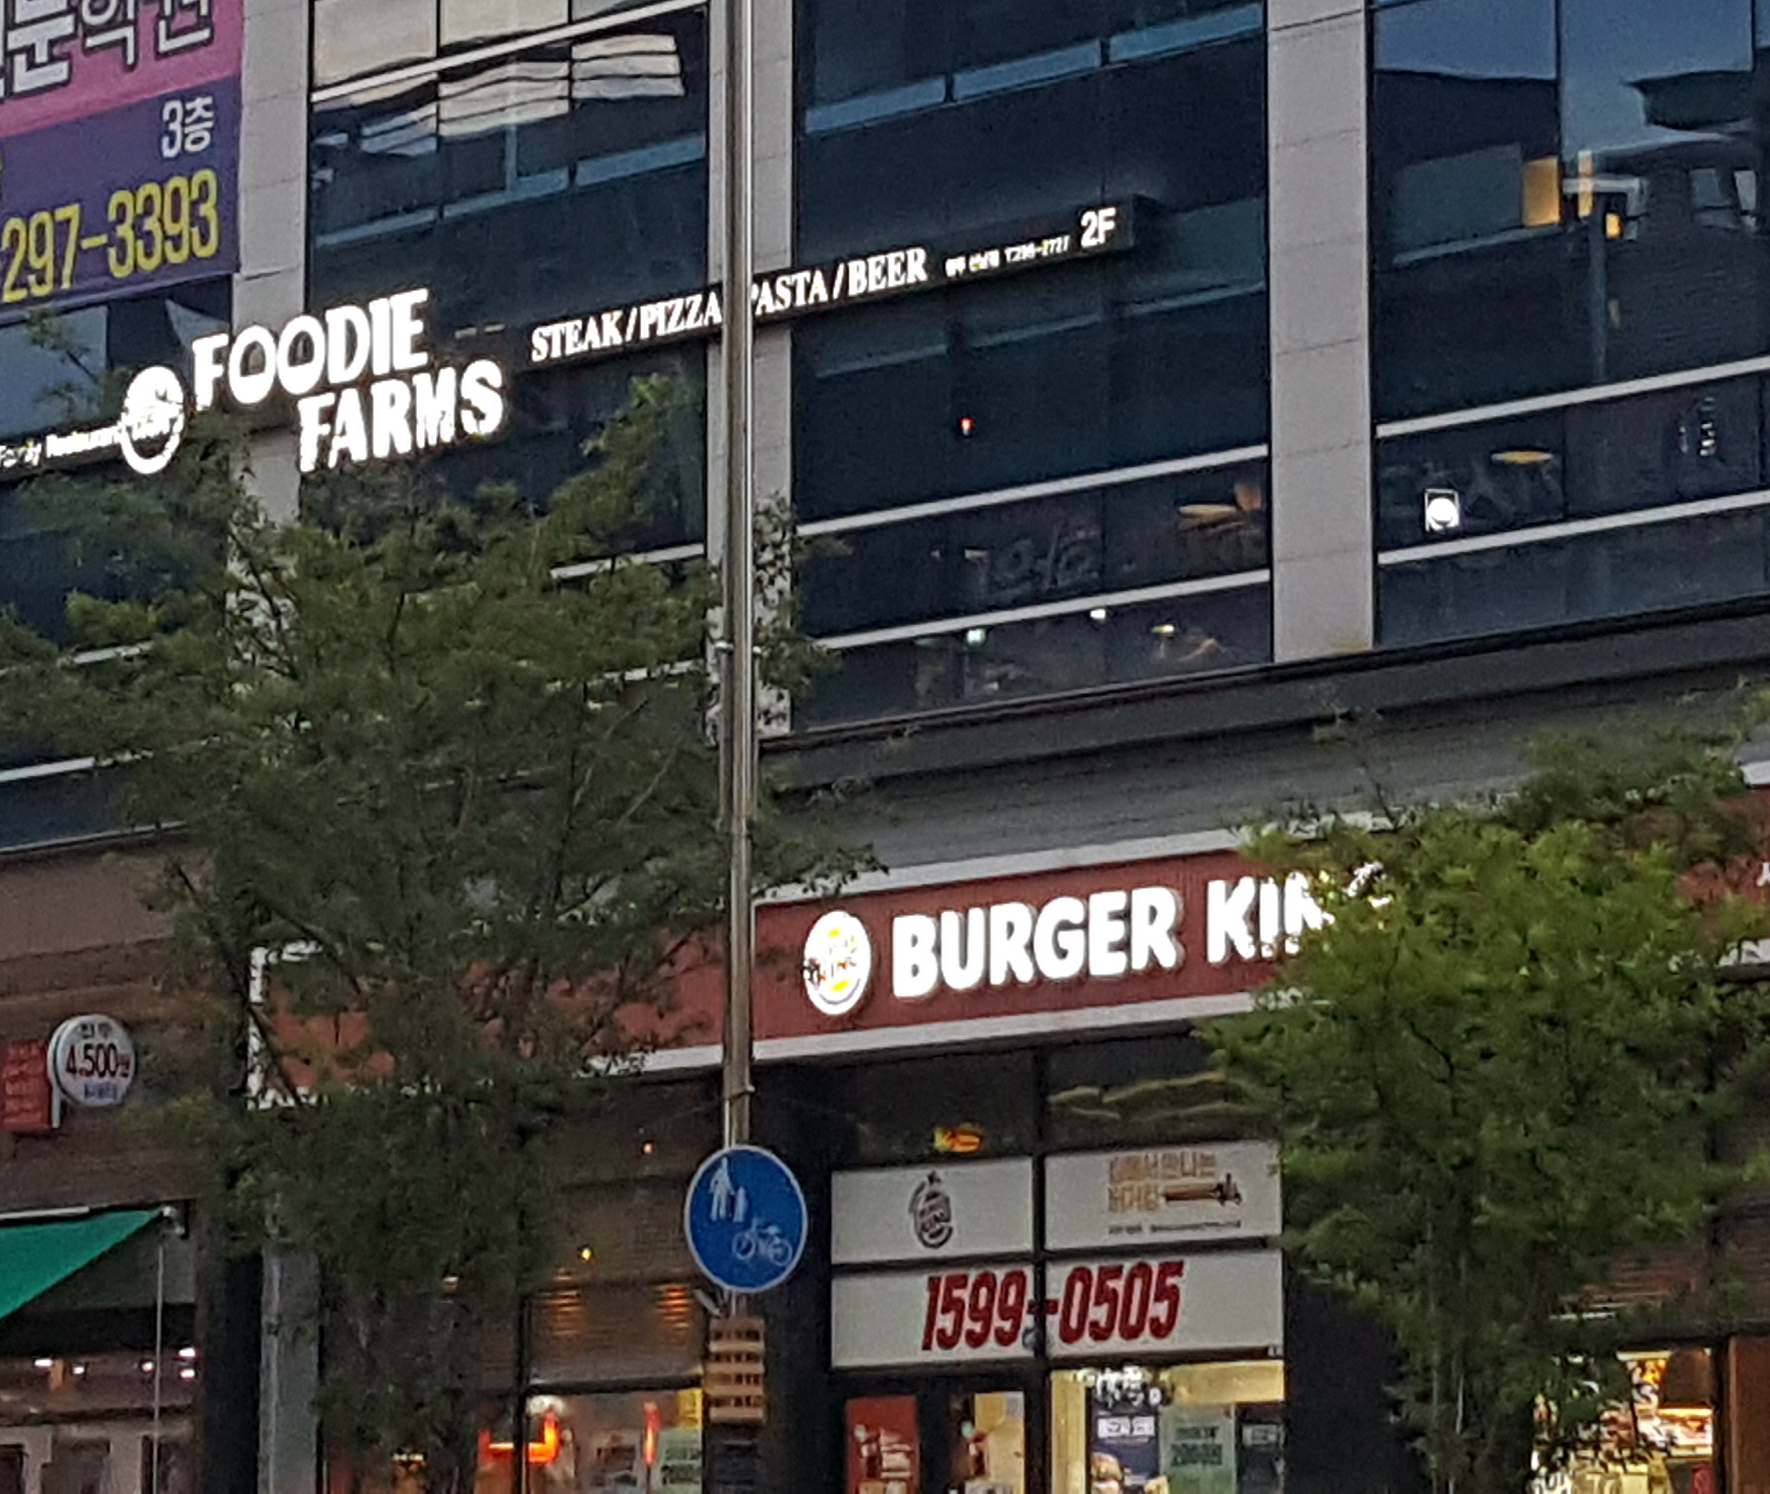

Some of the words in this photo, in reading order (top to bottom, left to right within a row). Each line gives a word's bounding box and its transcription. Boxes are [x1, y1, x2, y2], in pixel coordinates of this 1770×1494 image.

[160, 94, 215, 159] 3층
[1077, 206, 1121, 252] 2F
[188, 286, 433, 412] FOODIE
[297, 358, 507, 475] FARMS
[890, 885, 1184, 999] BURGER
[1205, 861, 1386, 966] KIN
[920, 1260, 1186, 1354] 1599-0505
